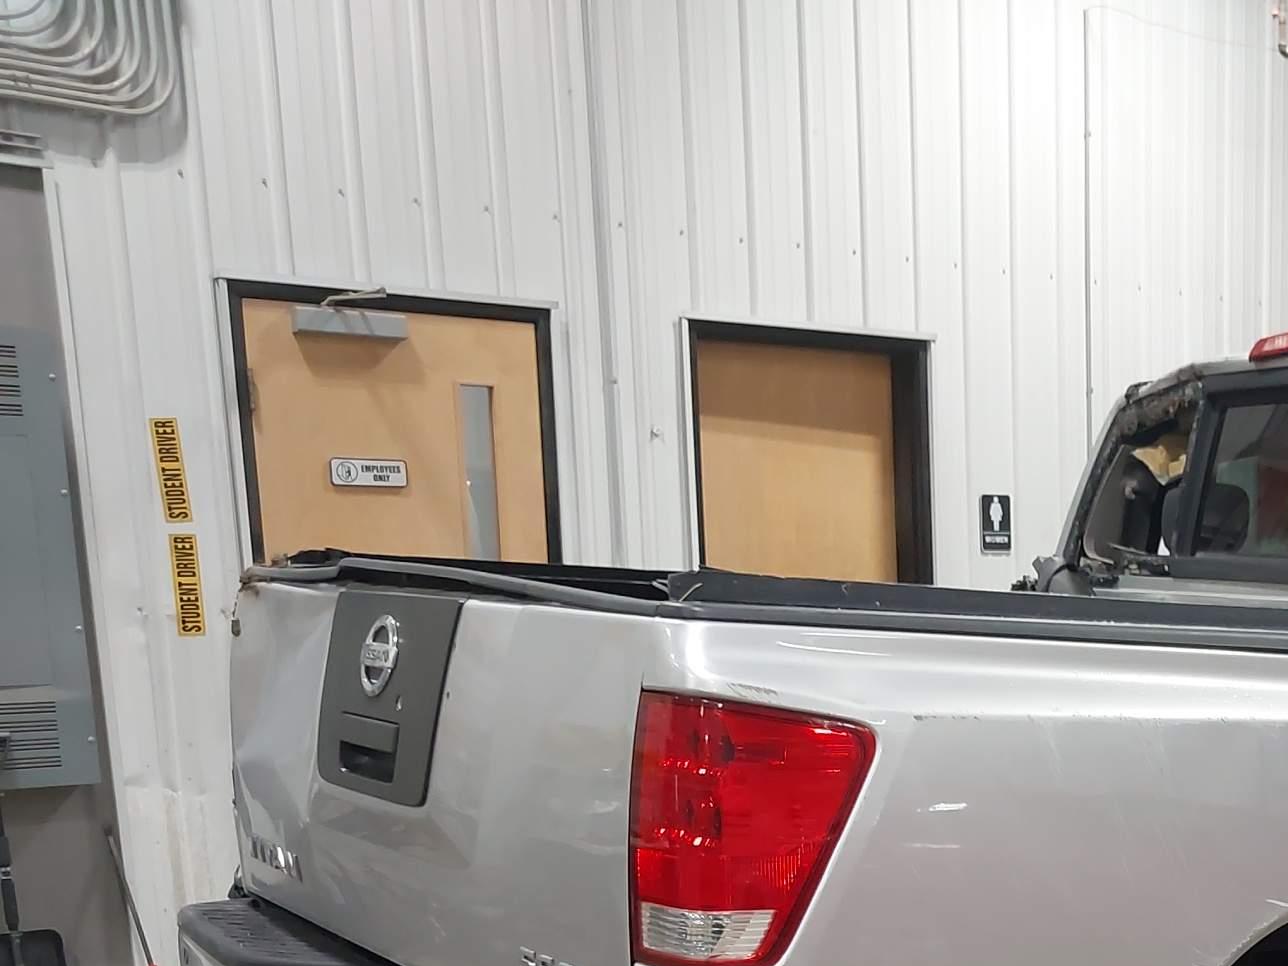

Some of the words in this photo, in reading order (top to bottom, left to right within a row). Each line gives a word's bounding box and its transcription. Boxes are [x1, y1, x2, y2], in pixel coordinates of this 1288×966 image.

[154, 419, 180, 463] DRIVER
[361, 464, 401, 474] EMPLOYEES
[373, 474, 391, 482] ONLY
[161, 466, 189, 520] STUDENT
[173, 535, 197, 578] DRIVER
[178, 581, 202, 633] STUDENT
